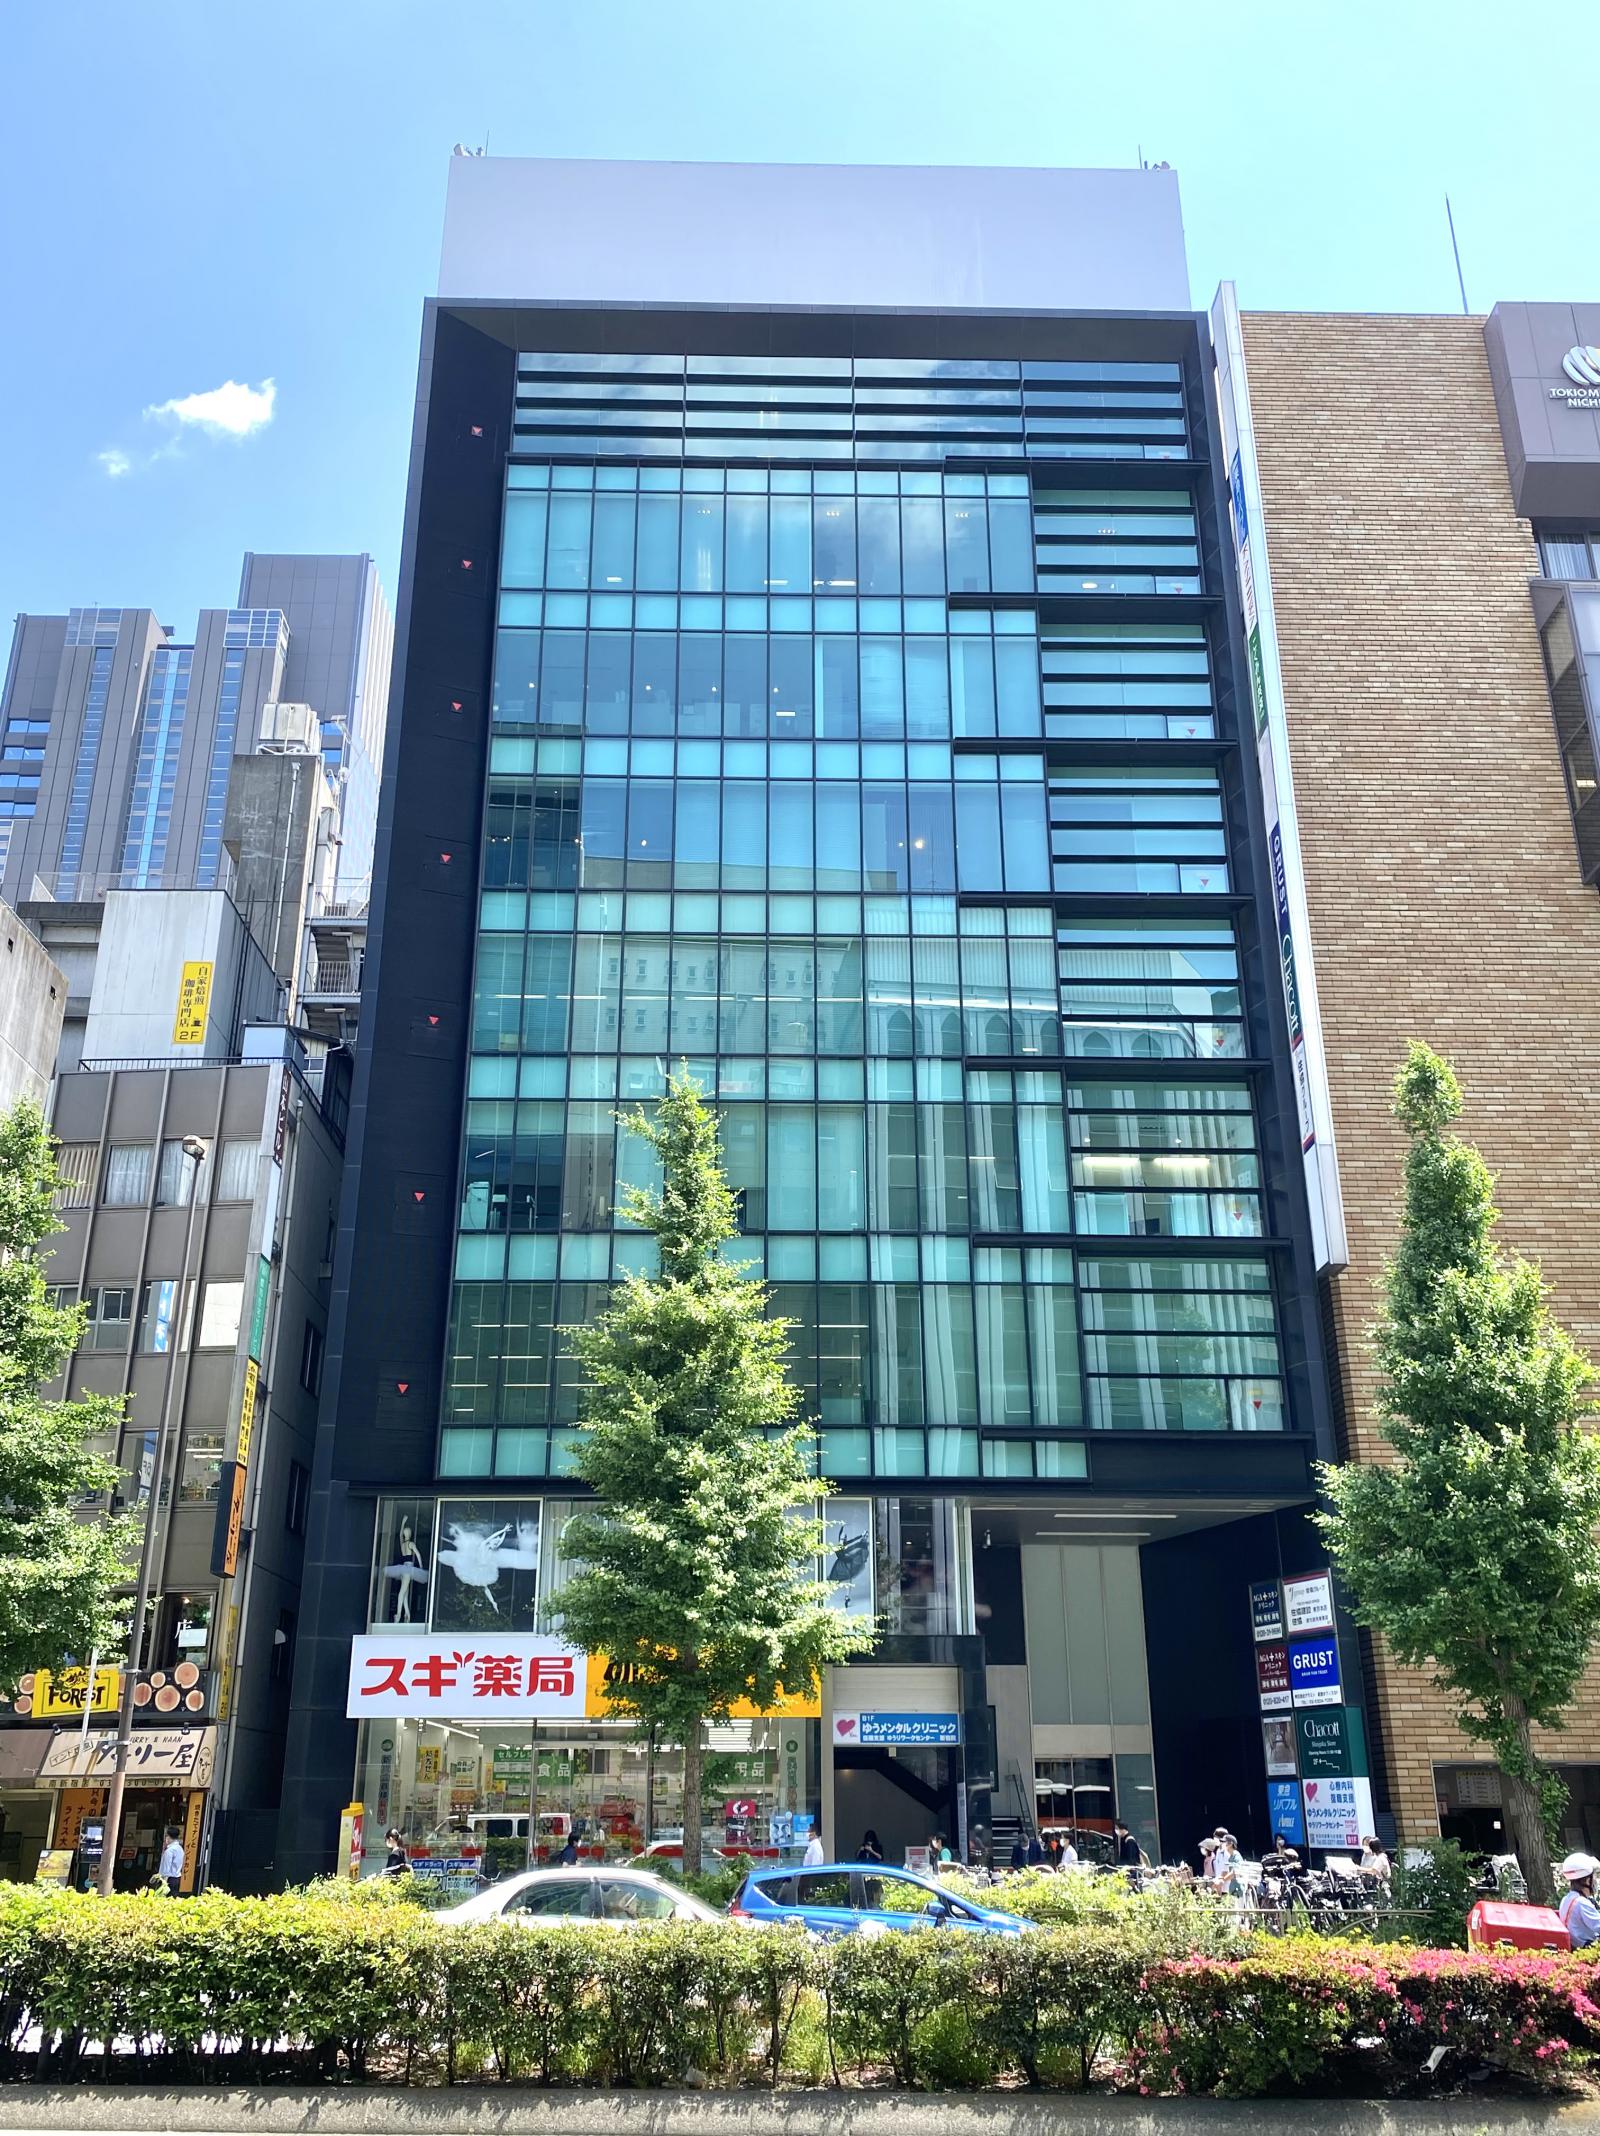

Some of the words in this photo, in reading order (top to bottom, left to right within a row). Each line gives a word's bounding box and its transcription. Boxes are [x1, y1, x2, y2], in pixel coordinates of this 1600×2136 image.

[1549, 388, 1587, 397] TOKIO
[1273, 834, 1288, 915] GRUST
[1281, 933, 1300, 1036] Chacott
[179, 1030, 199, 1040] 2F
[1293, 1650, 1333, 1670] GRUST
[360, 1651, 574, 1697] スギ薬局
[862, 1722, 957, 1734] ゆうメンタルクリニック
[1304, 1719, 1340, 1738] Chacott
[1307, 1807, 1356, 1818] ゆうメンタルクリニック
